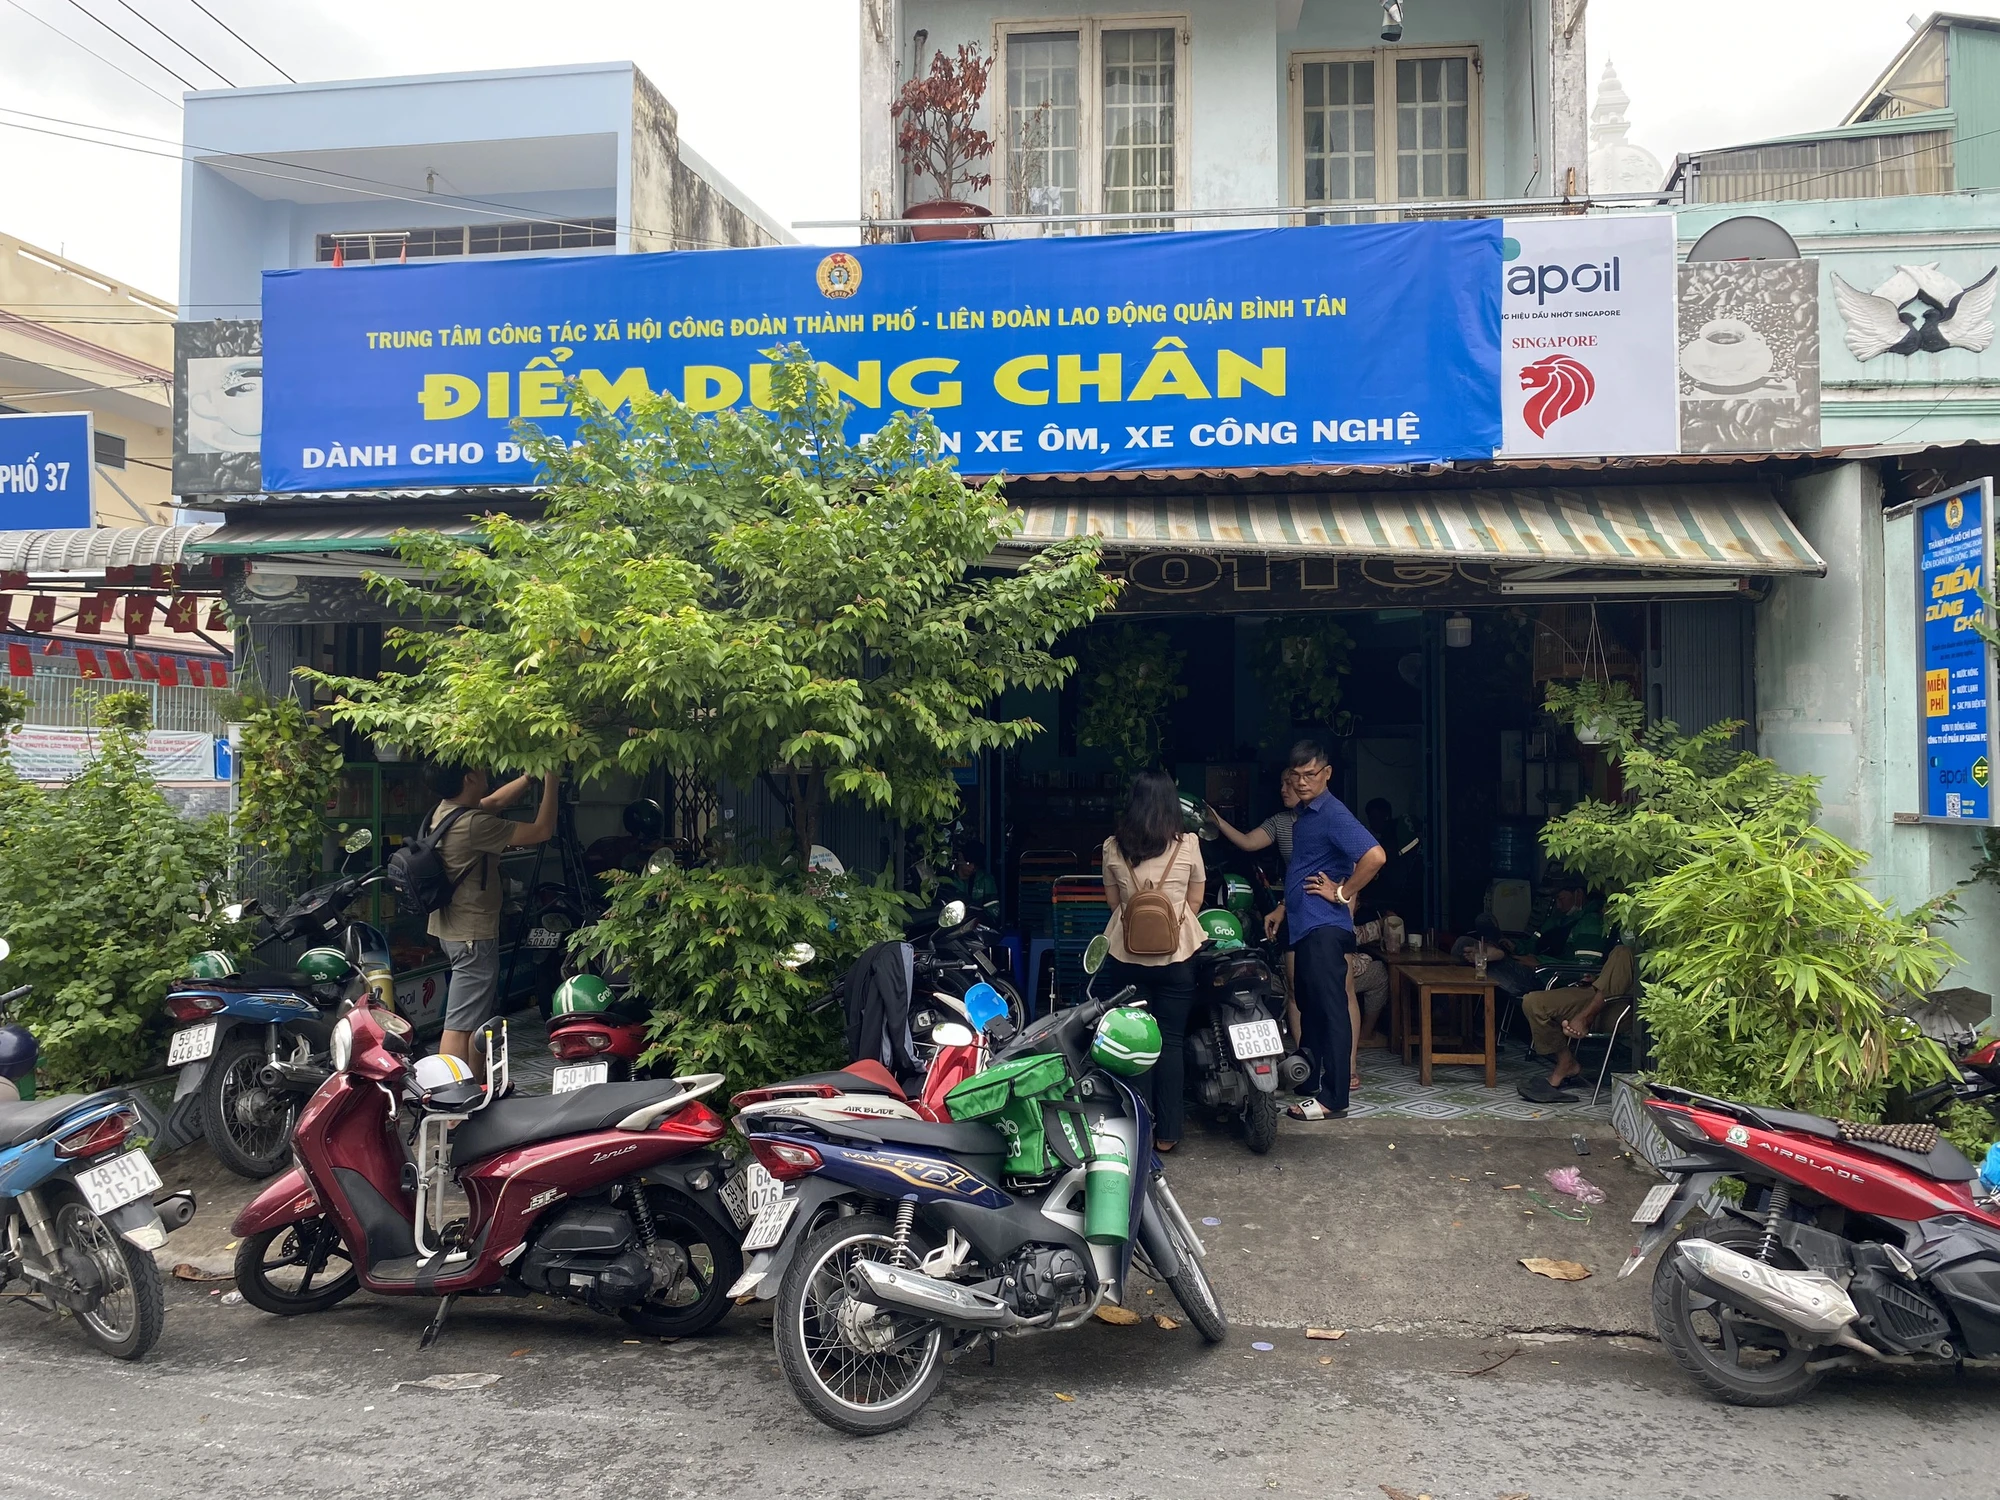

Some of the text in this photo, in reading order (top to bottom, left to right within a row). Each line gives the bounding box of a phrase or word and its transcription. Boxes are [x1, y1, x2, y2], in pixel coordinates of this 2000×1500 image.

[1507, 257, 1620, 305] apoil
[367, 331, 432, 348] TRUNG
[439, 328, 482, 346] TÂM
[487, 326, 542, 345] CÔNG
[549, 324, 585, 342] TÁC
[594, 322, 620, 340] XÃ
[626, 321, 662, 340] HỘI
[667, 319, 724, 338] CÔNG
[729, 317, 787, 337] ĐOÀN
[794, 315, 865, 334] THÀNH
[871, 312, 916, 332] PHỐ
[936, 310, 985, 330] LIÊN
[991, 308, 1051, 328] ĐOÀN
[1057, 307, 1100, 326] LAO
[1106, 304, 1167, 324] ĐỘNG
[1172, 302, 1233, 324] QUẬN
[1239, 300, 1294, 320] BÌNH
[1302, 298, 1347, 317] TÂN
[1511, 312, 1530, 320] HIỆU
[1512, 335, 1598, 349] SINGAPORE
[417, 347, 651, 420] ĐIỂM
[993, 336, 1286, 406] CHÂN
[303, 442, 396, 468] DÀNH
[411, 443, 483, 464] CHO
[976, 431, 1022, 452] XE
[1039, 424, 1109, 453] ÔM,
[1125, 426, 1173, 448] XE
[1195, 418, 1296, 446] CÔNG
[1314, 412, 1419, 444] NGHỆ
[0, 452, 71, 494] PHỐ 37
[1928, 540, 1945, 550] THÀNH
[1945, 534, 1955, 545] PHỐ
[1931, 695, 1944, 711] PHÍ
[1215, 926, 1235, 937] Grab
[178, 1027, 208, 1046] 59-E1
[1237, 1023, 1271, 1041] 63-B8
[172, 1042, 210, 1063] 948.93
[1237, 1037, 1280, 1057] 686.80
[563, 1067, 597, 1085] 50-N1
[864, 1106, 895, 1115] BLADE
[841, 1151, 895, 1164] WAVE
[91, 1156, 139, 1188] 48-H1
[92, 1171, 156, 1211] 215.24
[724, 1174, 747, 1204] 59-V2
[760, 1202, 791, 1224] 59-H2
[748, 1223, 782, 1246] 121.88
